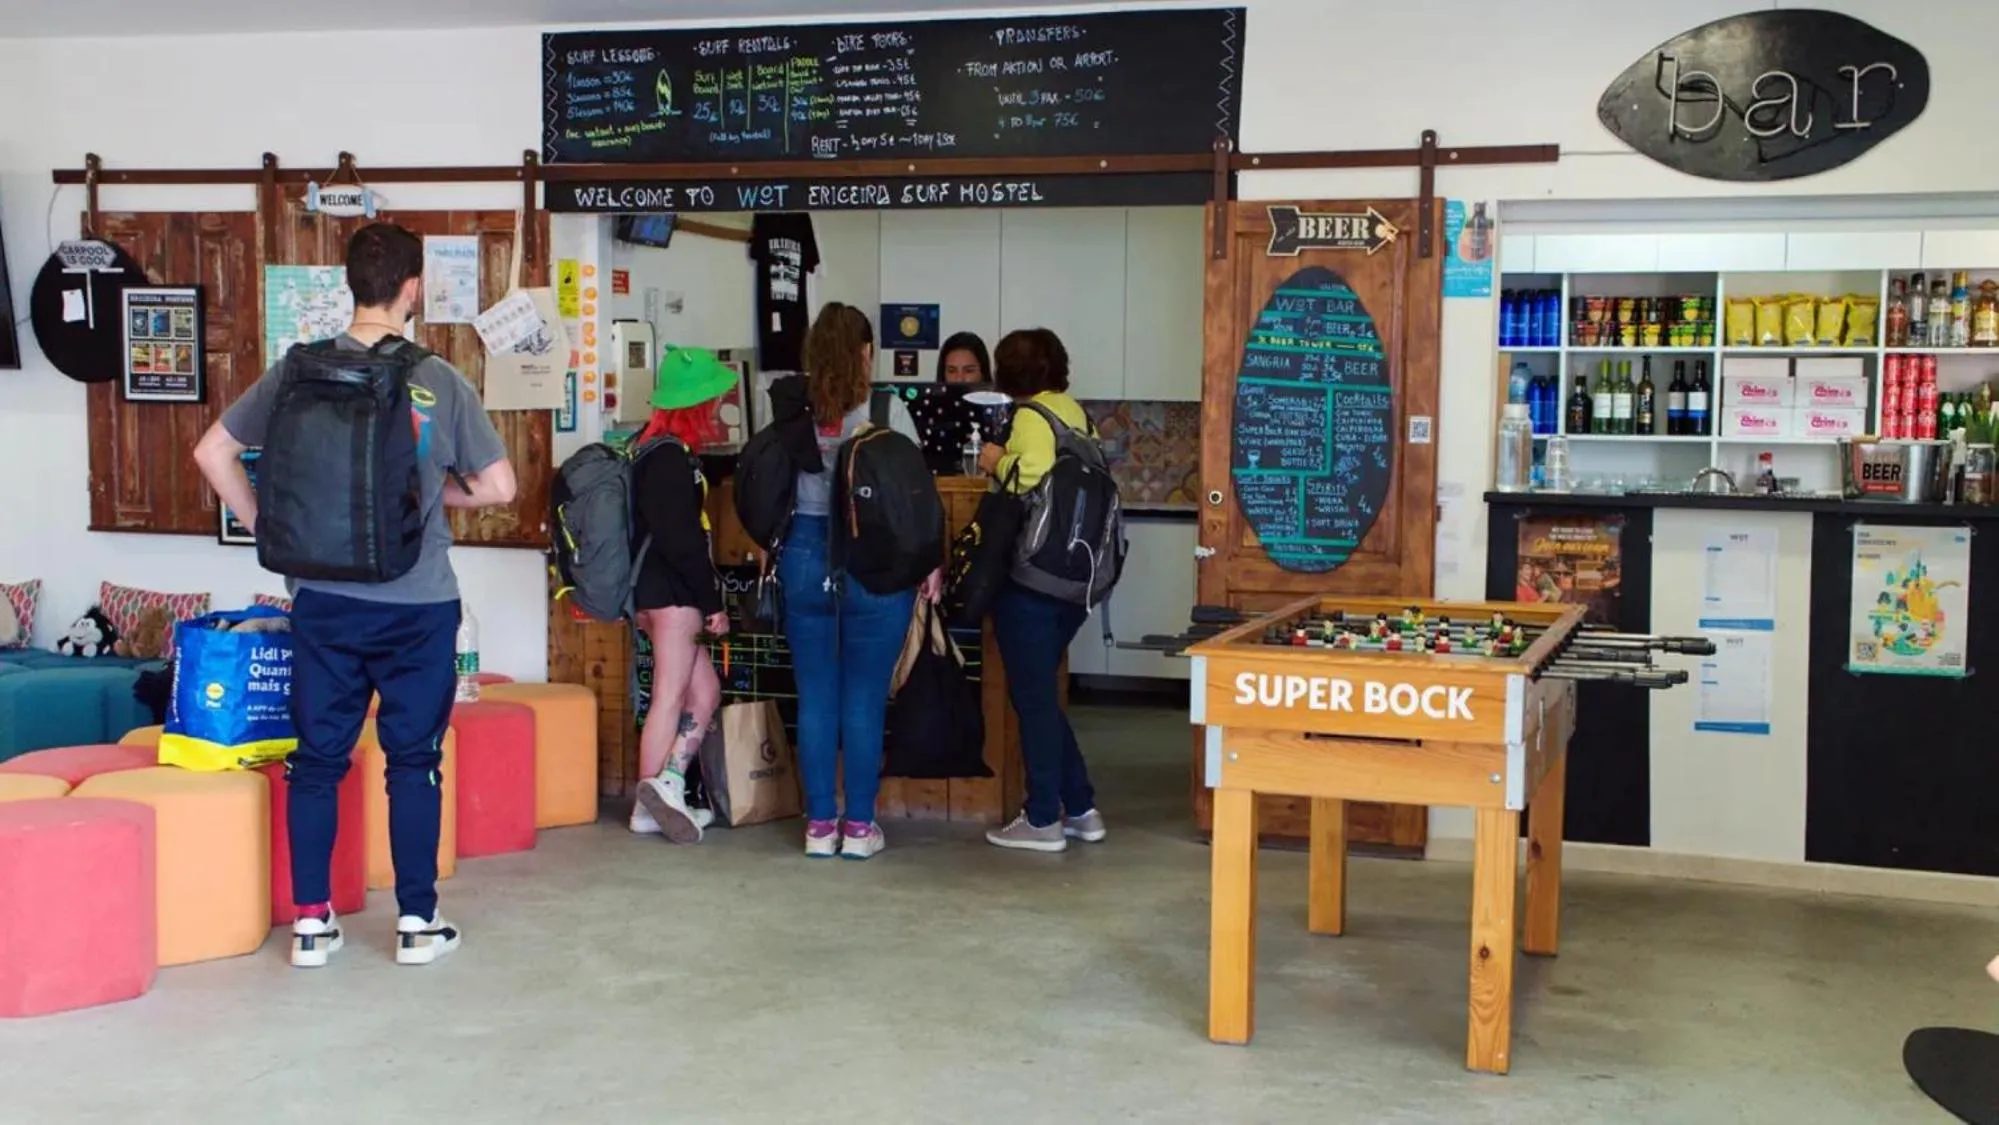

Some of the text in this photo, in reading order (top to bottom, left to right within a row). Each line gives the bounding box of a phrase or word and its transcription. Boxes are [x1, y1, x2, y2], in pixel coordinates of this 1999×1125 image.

[995, 26, 1081, 46] TRANSFERS
[699, 37, 790, 56] SURF RENTALS
[567, 49, 597, 65] SURF
[964, 60, 998, 77] FROM
[1050, 56, 1067, 70] OR
[1669, 56, 1897, 136] bar
[811, 135, 841, 153] RENT
[319, 194, 363, 207] WELCOME
[575, 187, 675, 209] WELCOME
[687, 189, 715, 207] TO
[808, 184, 892, 207] ERICEIRA
[901, 183, 952, 205] SURF
[960, 182, 1044, 203] HOSTEL
[1298, 216, 1370, 239] BEER
[62, 245, 110, 256] CARPOOL
[67, 255, 107, 266] IS COOL
[1326, 300, 1355, 314] BAR
[1245, 353, 1292, 369] SANGRIA
[1344, 361, 1380, 377] BEER
[1863, 463, 1901, 480] BEER
[251, 647, 278, 661] Lidl
[248, 678, 280, 692] mais
[1234, 671, 1474, 720] SUPER BOCK
